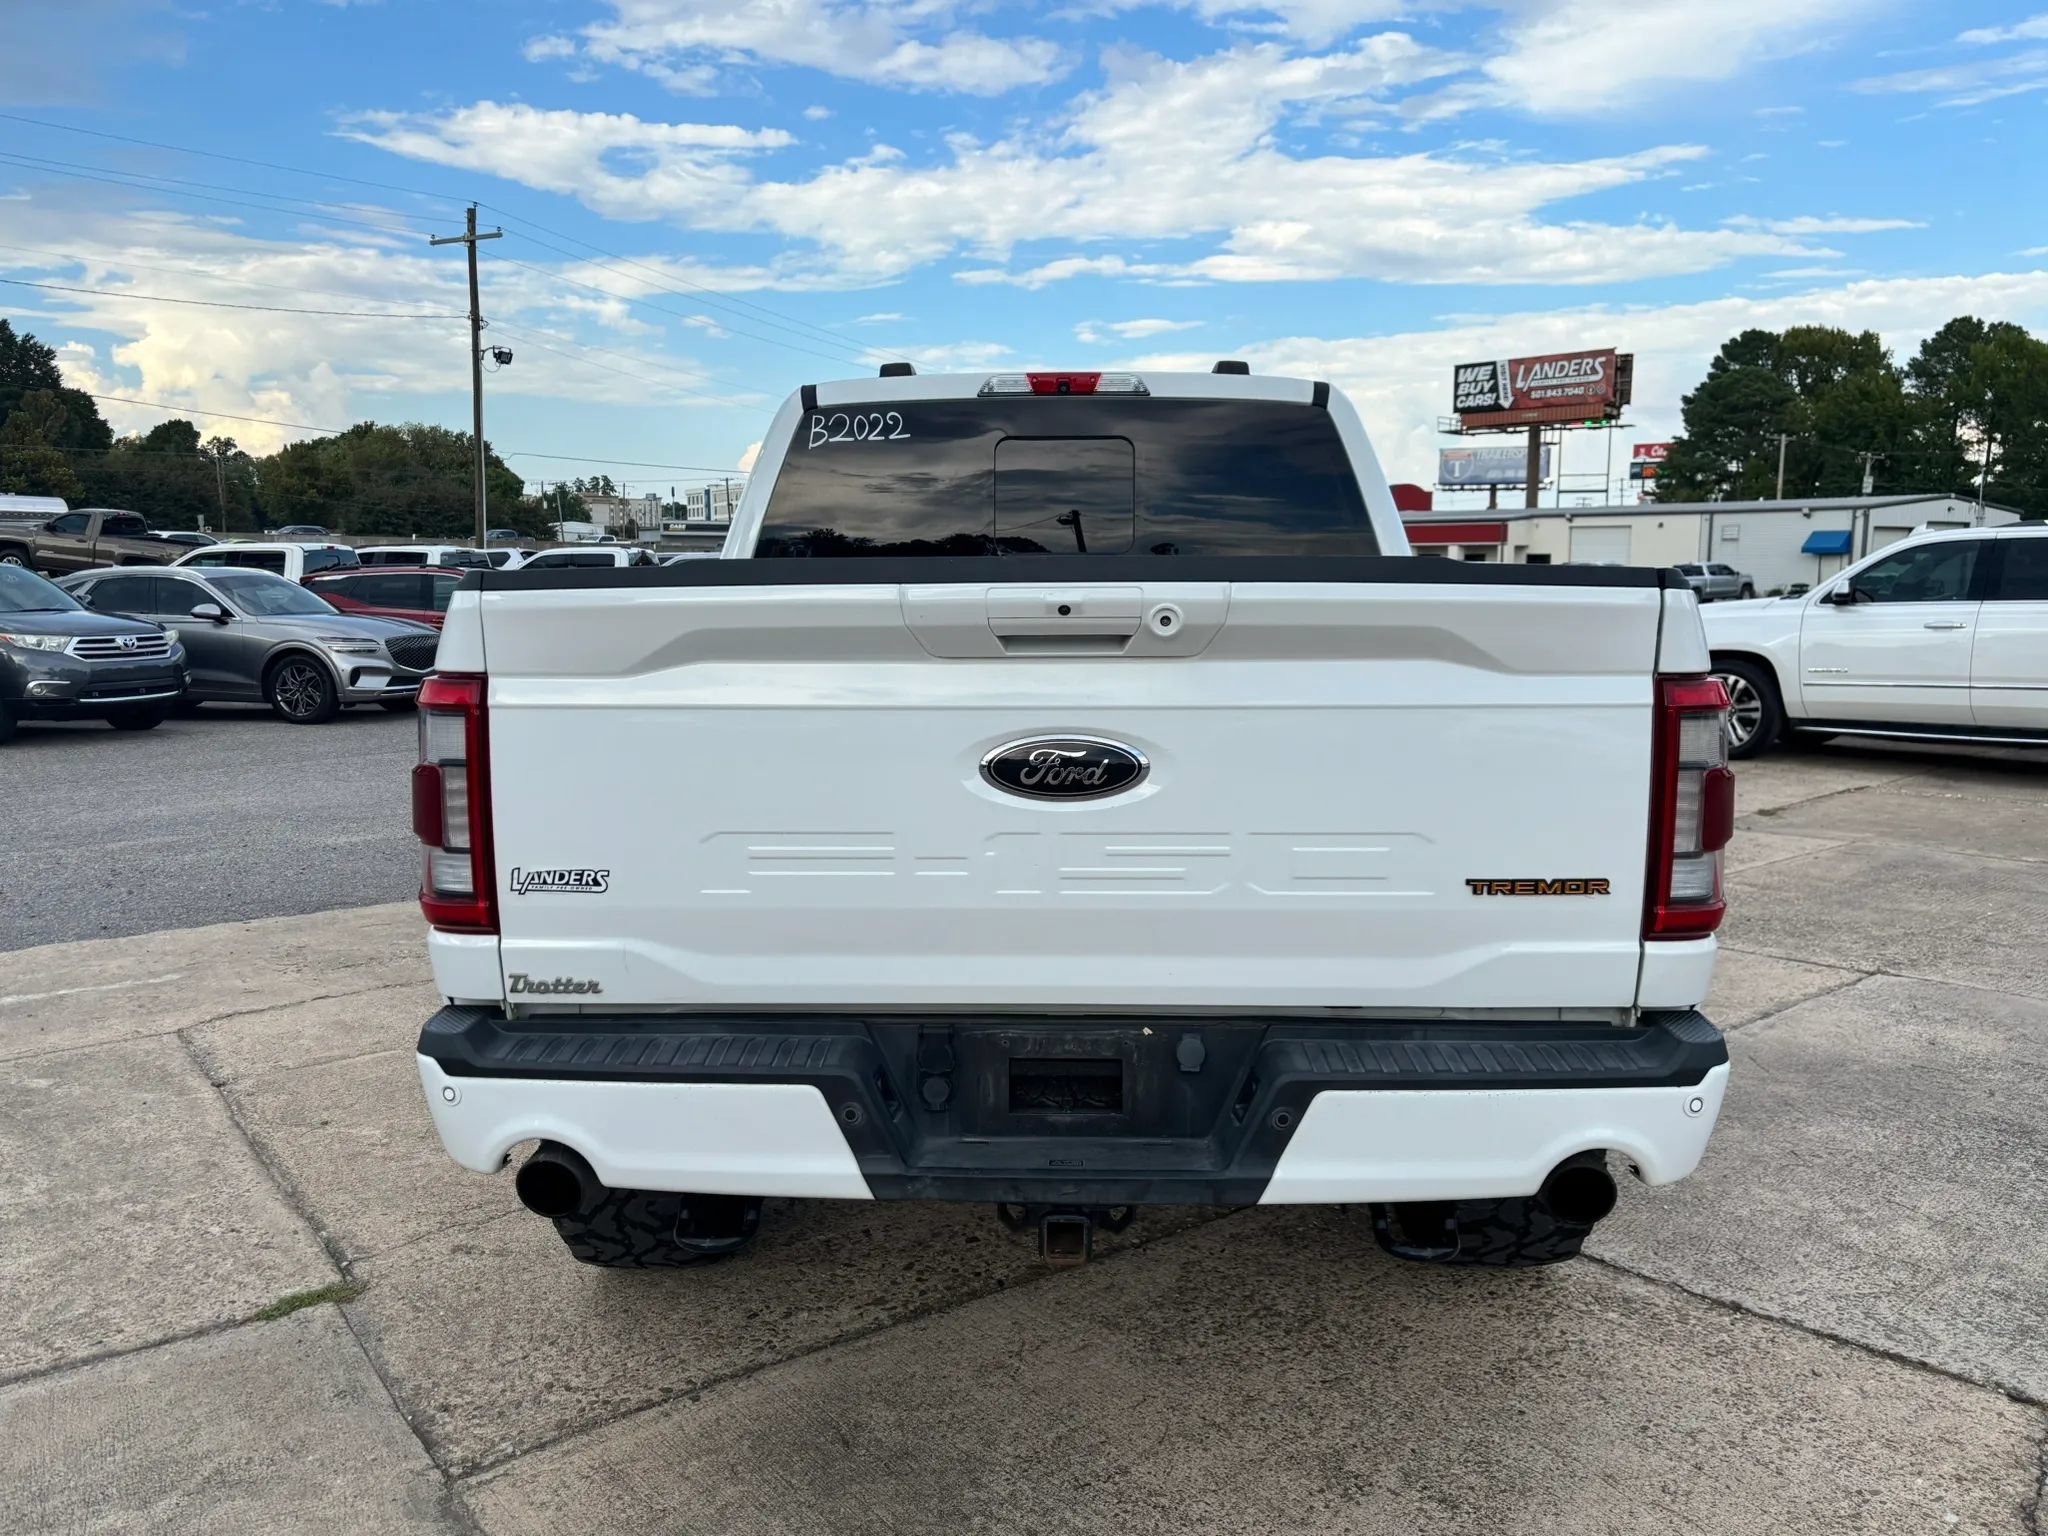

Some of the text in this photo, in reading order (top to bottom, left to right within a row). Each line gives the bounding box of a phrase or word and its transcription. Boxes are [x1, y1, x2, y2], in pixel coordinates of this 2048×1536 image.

[1457, 365, 1494, 383] WE
[1515, 356, 1607, 392] LANDERS
[1456, 380, 1495, 395] BUY
[1455, 393, 1496, 409] CARS!
[808, 411, 911, 450] B2022
[1020, 749, 1110, 785] Ford
[510, 866, 610, 895] LANDERS
[1465, 878, 1611, 895] TREMOR
[508, 973, 604, 994] Trotter
